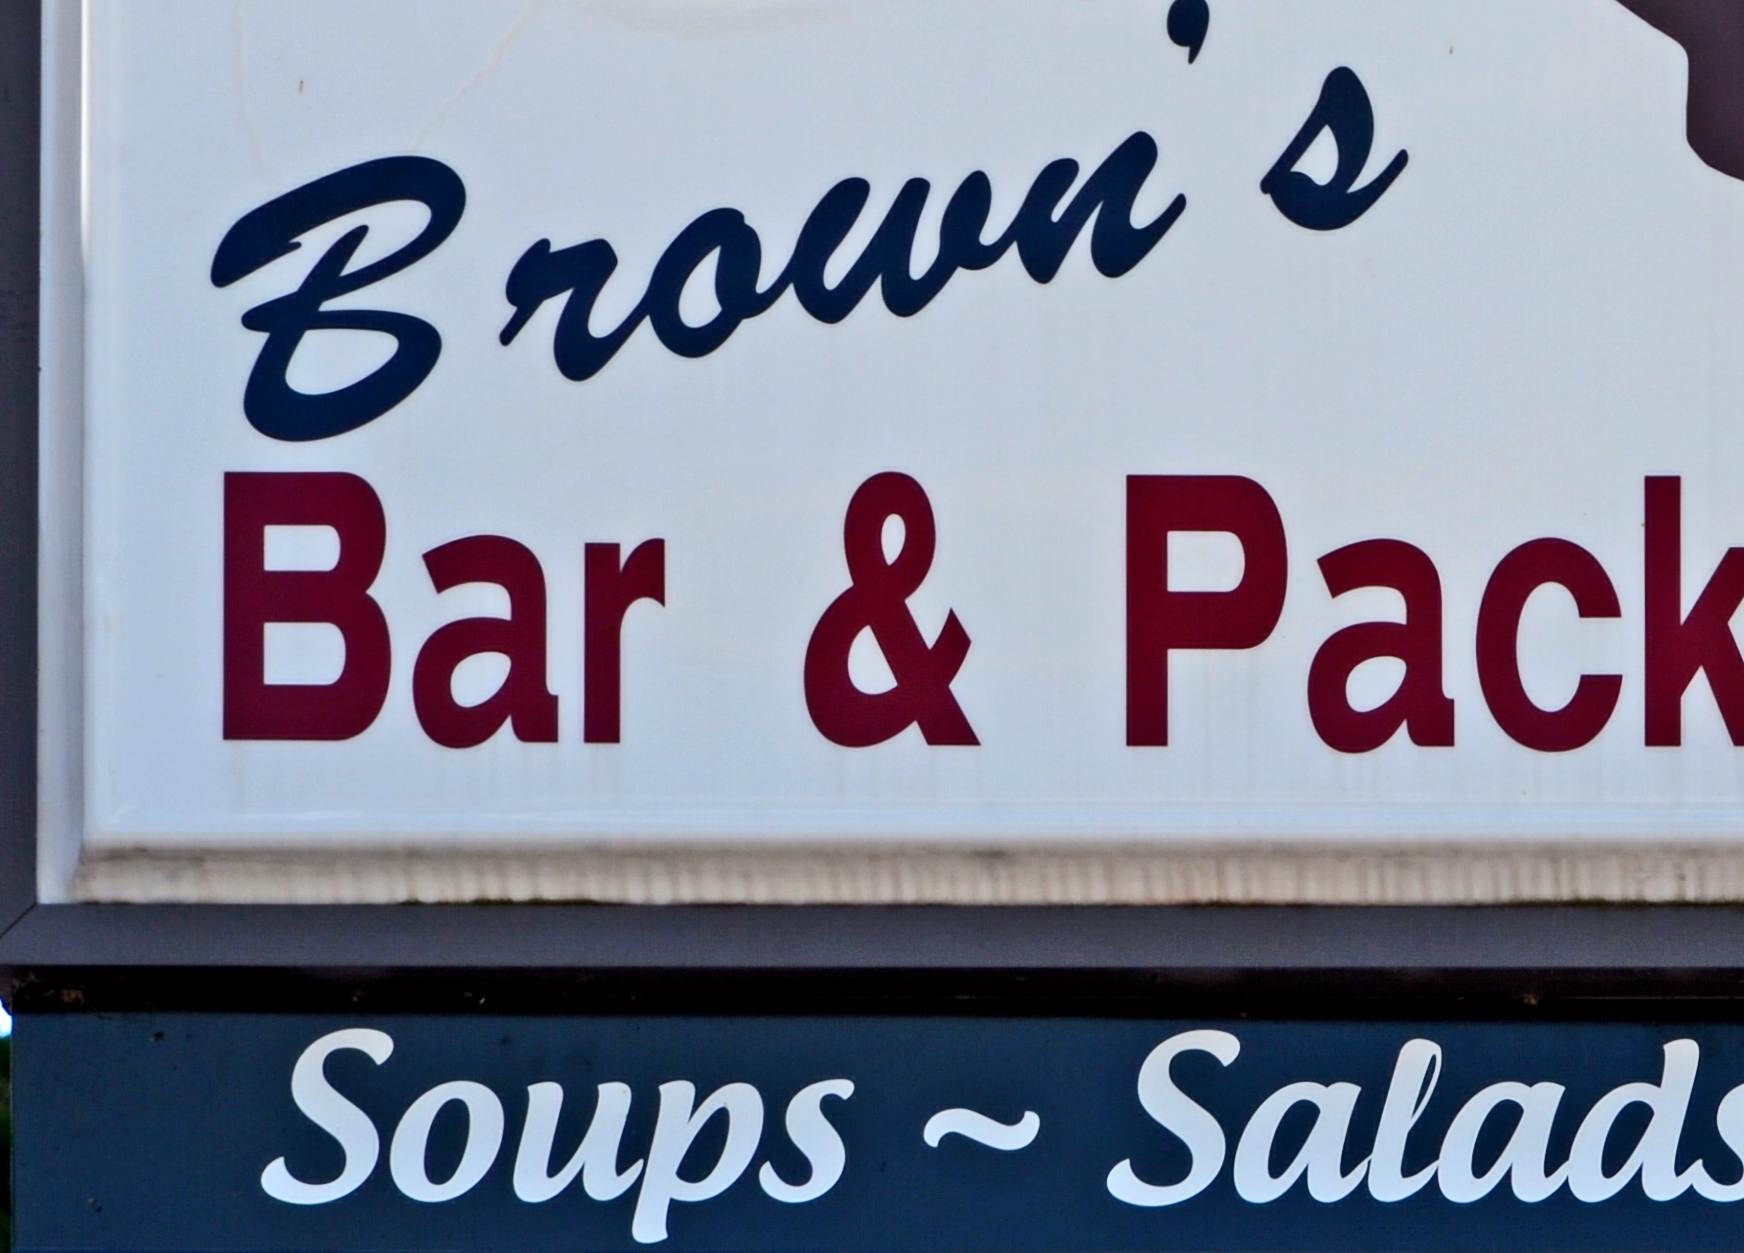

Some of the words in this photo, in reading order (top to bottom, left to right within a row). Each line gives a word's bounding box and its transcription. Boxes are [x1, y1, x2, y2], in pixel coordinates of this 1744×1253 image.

[221, 470, 667, 751] Bar
[802, 470, 982, 749] &
[257, 1026, 857, 1247] Soups
